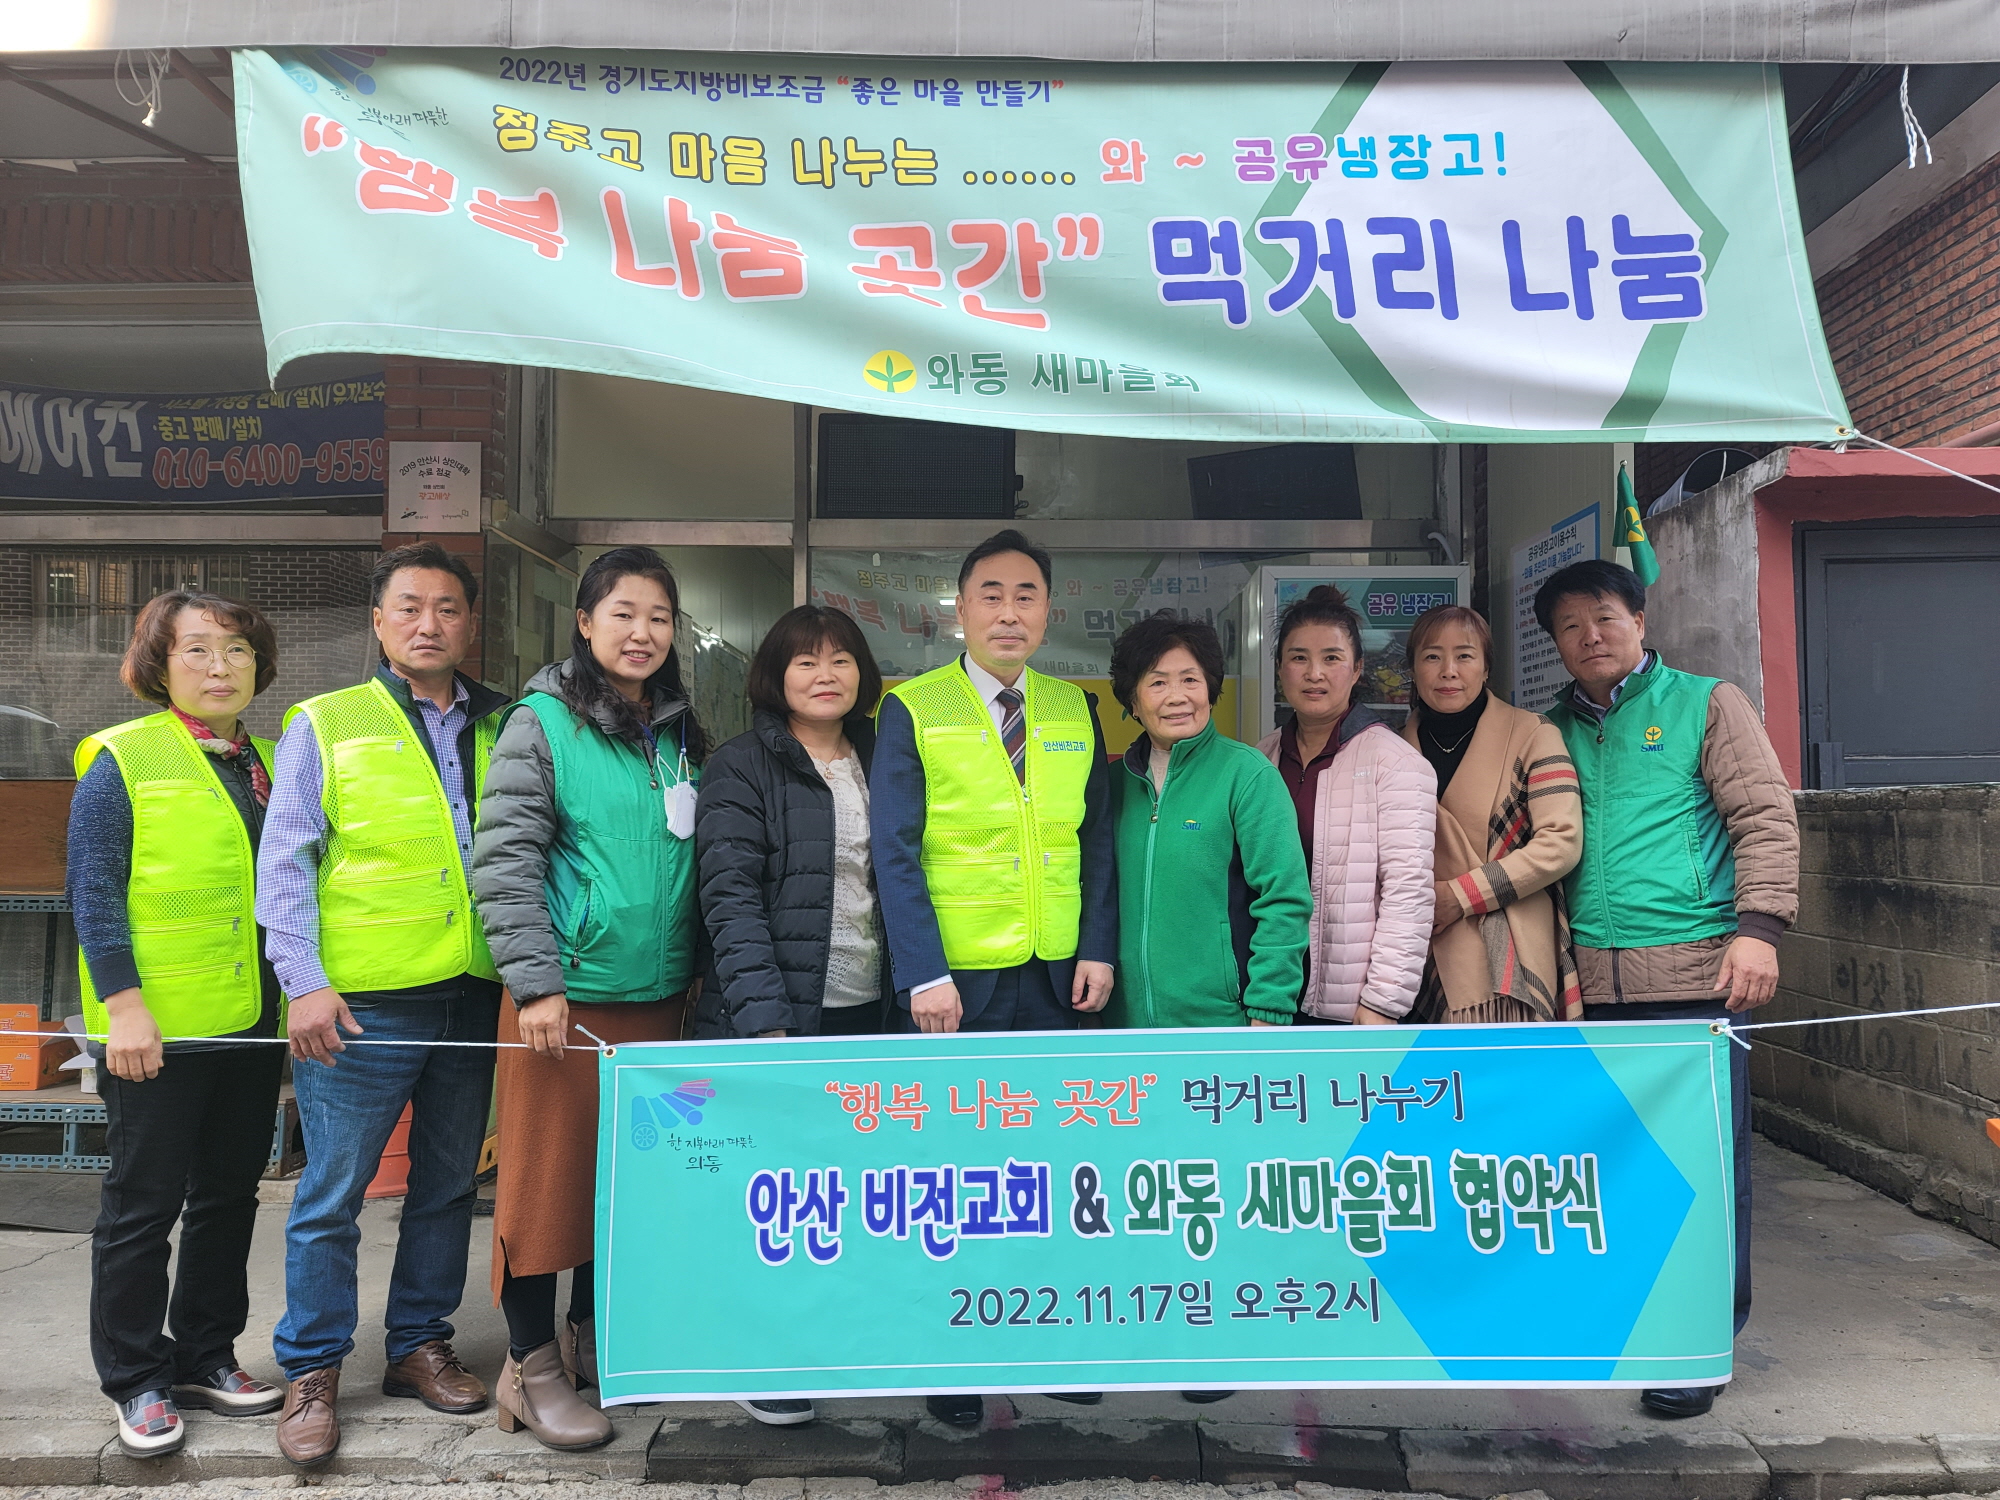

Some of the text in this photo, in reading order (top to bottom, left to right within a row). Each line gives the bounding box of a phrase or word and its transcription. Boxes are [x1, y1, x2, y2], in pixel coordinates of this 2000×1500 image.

[500, 56, 587, 93] 2022년
[598, 63, 826, 104] 경기도지방비보조금
[913, 79, 964, 107] 마을
[976, 79, 1064, 108] 만들기”
[668, 131, 767, 186] 마음
[791, 136, 938, 189] 나누는
[1101, 138, 1147, 184] 와
[1234, 131, 1508, 183] 공유냉장고!
[599, 186, 807, 302] 나눔
[1149, 215, 1460, 327] 먹거리
[1501, 213, 1707, 322] 나눔
[926, 352, 1202, 396] 와동 새마을회
[0, 390, 148, 478] 에어컨
[153, 438, 384, 489] 010-6400-9559
[399, 455, 471, 476] 2019 안산시 상인대학
[418, 467, 452, 478] 수료 점포
[418, 492, 451, 500] 광고세상
[1528, 524, 1577, 562] 공유냉장고이용수칙
[856, 569, 908, 592] 정주고
[1066, 579, 1082, 597] 와
[1112, 576, 1208, 598] 공유냉장고!
[1367, 592, 1398, 616] 공유
[1043, 741, 1086, 752] 안산비전교회
[1641, 743, 1664, 752] SMU
[1181, 821, 1201, 830] SMU
[824, 1070, 1464, 1133] “행복 나눔 곳간” 먹거리 나누기
[666, 1133, 682, 1151] 한
[726, 1134, 757, 1149] 따뜻한
[685, 1155, 723, 1173] 와동
[747, 1149, 1607, 1265] 안산 비전교회 & 와동 새마을회 협약식
[948, 1276, 1381, 1328] 2022.11.17일 오후2시
